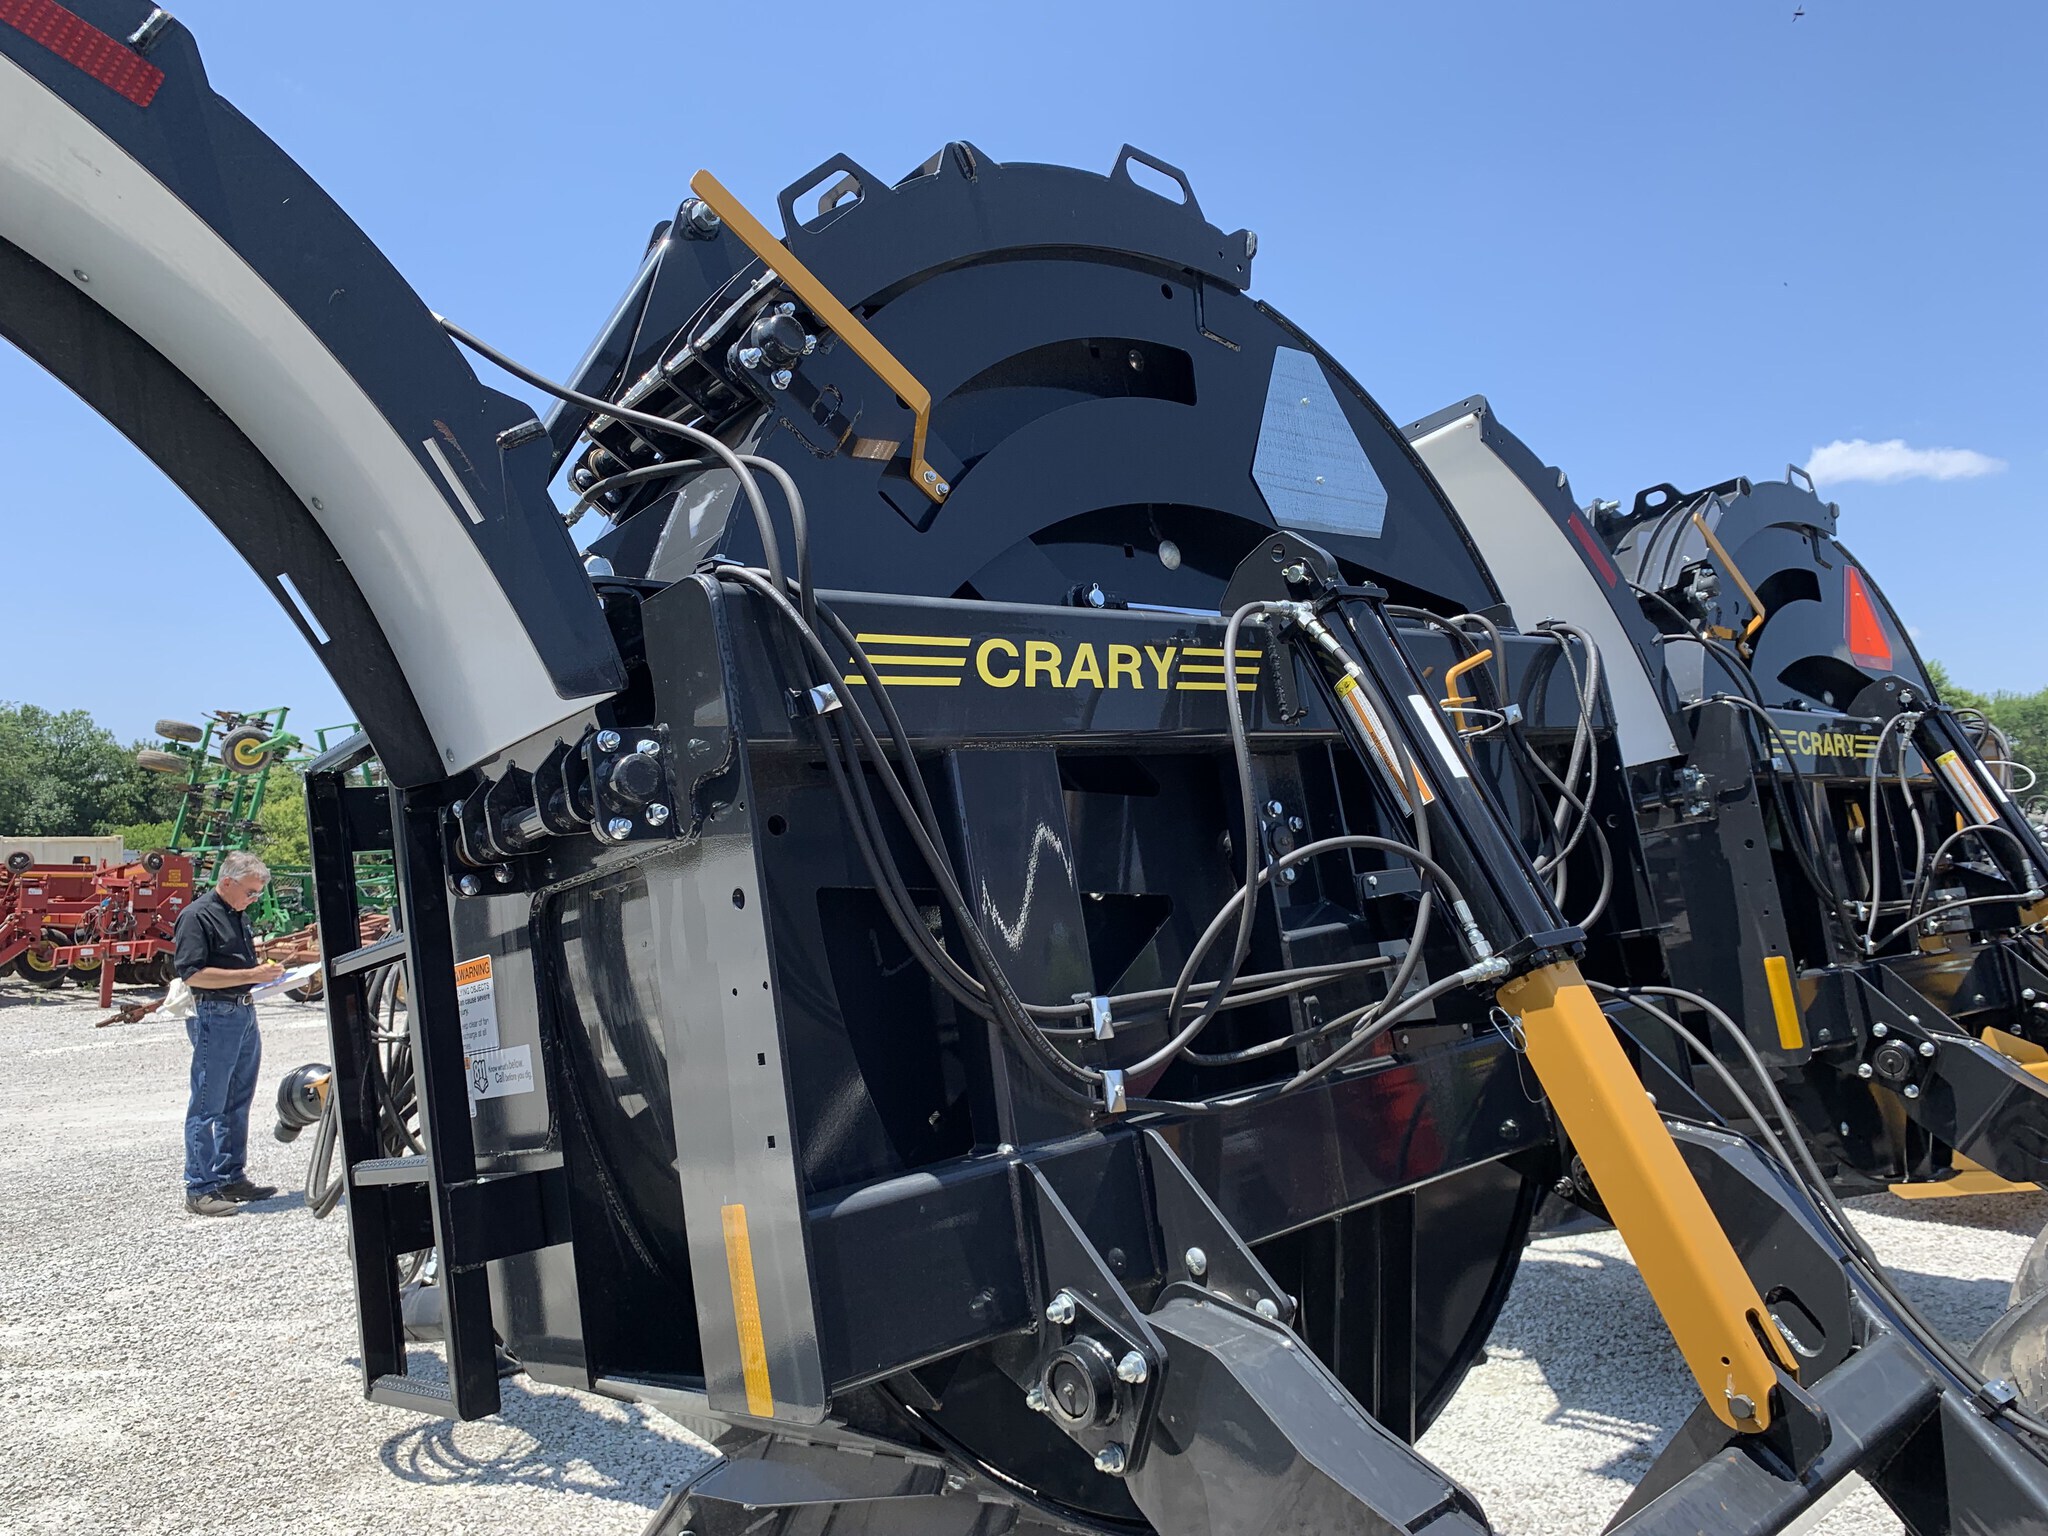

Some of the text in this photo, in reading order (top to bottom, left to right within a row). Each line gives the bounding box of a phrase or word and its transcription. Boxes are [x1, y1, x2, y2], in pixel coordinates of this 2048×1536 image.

[975, 638, 1178, 690] CRARY
[1798, 730, 1855, 757] CRARY
[458, 962, 490, 979] WARNING
[470, 982, 490, 994] OBJECTS
[473, 1059, 488, 1081] 811
[495, 1071, 505, 1083] Call
